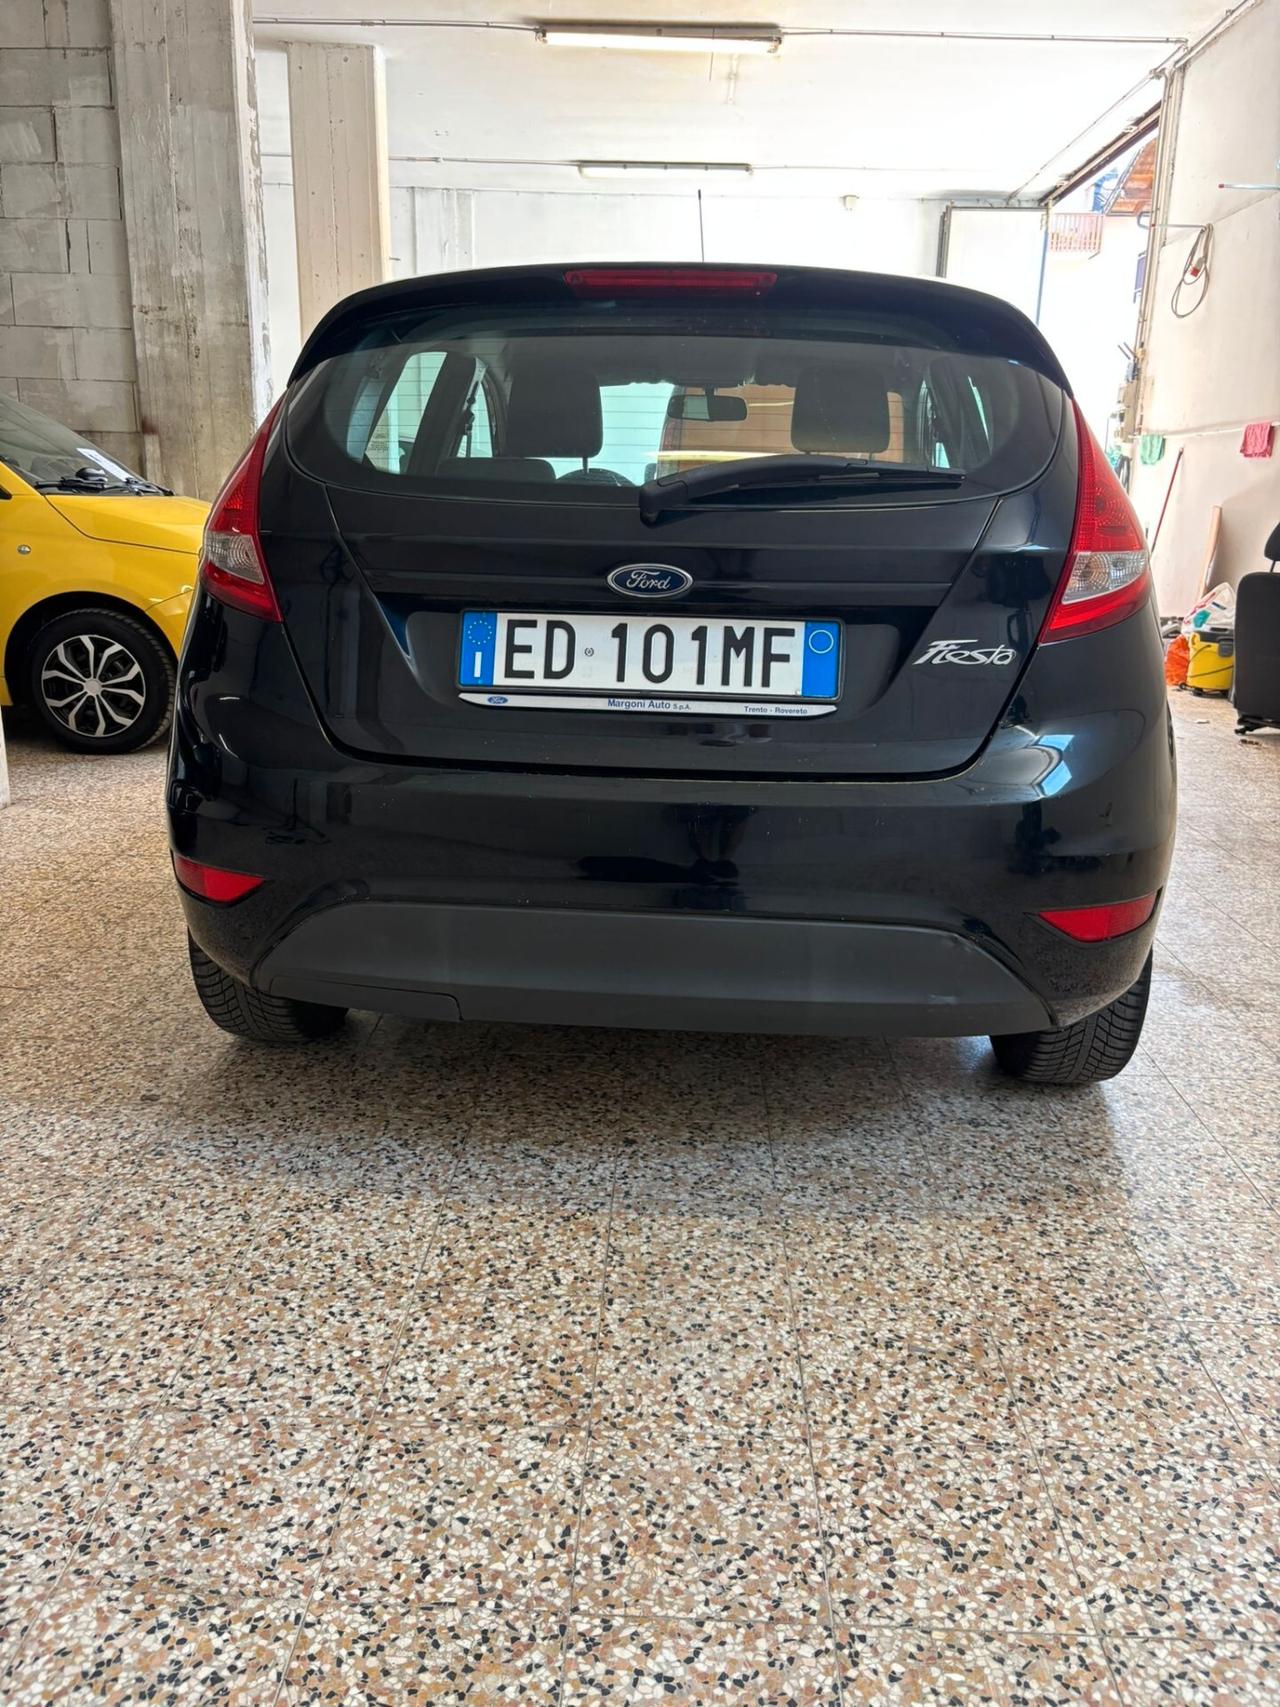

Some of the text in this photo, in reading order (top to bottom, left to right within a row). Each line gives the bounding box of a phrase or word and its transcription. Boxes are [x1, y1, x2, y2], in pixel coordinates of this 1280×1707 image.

[626, 570, 671, 589] Ford
[504, 619, 575, 680] ED
[912, 639, 1017, 665] Fiesta
[474, 651, 482, 678] I
[607, 698, 646, 710] Margoni
[648, 700, 671, 710] Auto
[744, 706, 768, 714] Trento
